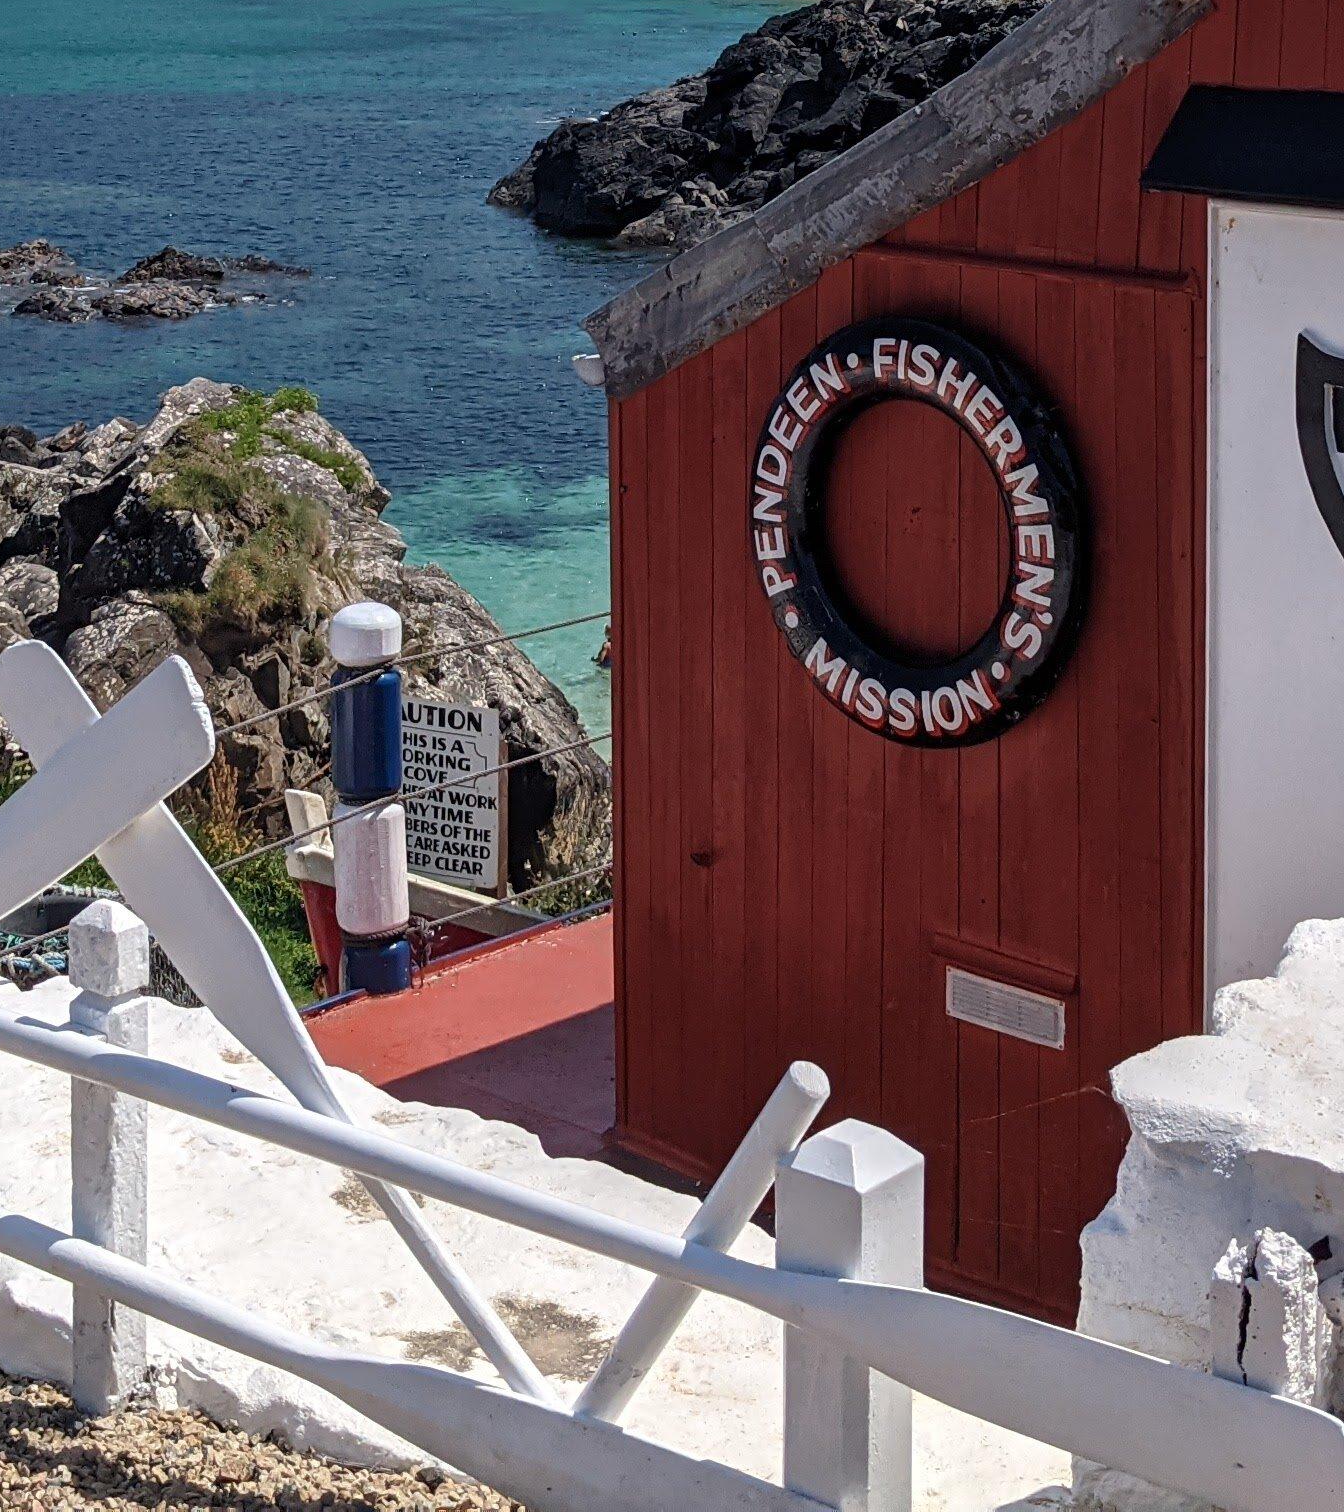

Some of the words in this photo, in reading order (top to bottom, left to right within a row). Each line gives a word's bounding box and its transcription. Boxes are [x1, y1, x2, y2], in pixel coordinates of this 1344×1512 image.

[753, 352, 846, 598] PENDEEN
[872, 337, 1055, 659] FISHERMEN'S
[804, 637, 993, 732] MISSION
[432, 736, 446, 751] IS
[450, 739, 464, 754] A
[402, 748, 471, 772] ORKING
[448, 791, 498, 810] WORK
[440, 824, 462, 839] OF
[463, 826, 491, 843] THE
[414, 835, 440, 853] ARE
[441, 840, 491, 860] ASKED
[435, 856, 484, 876] CLEAR
